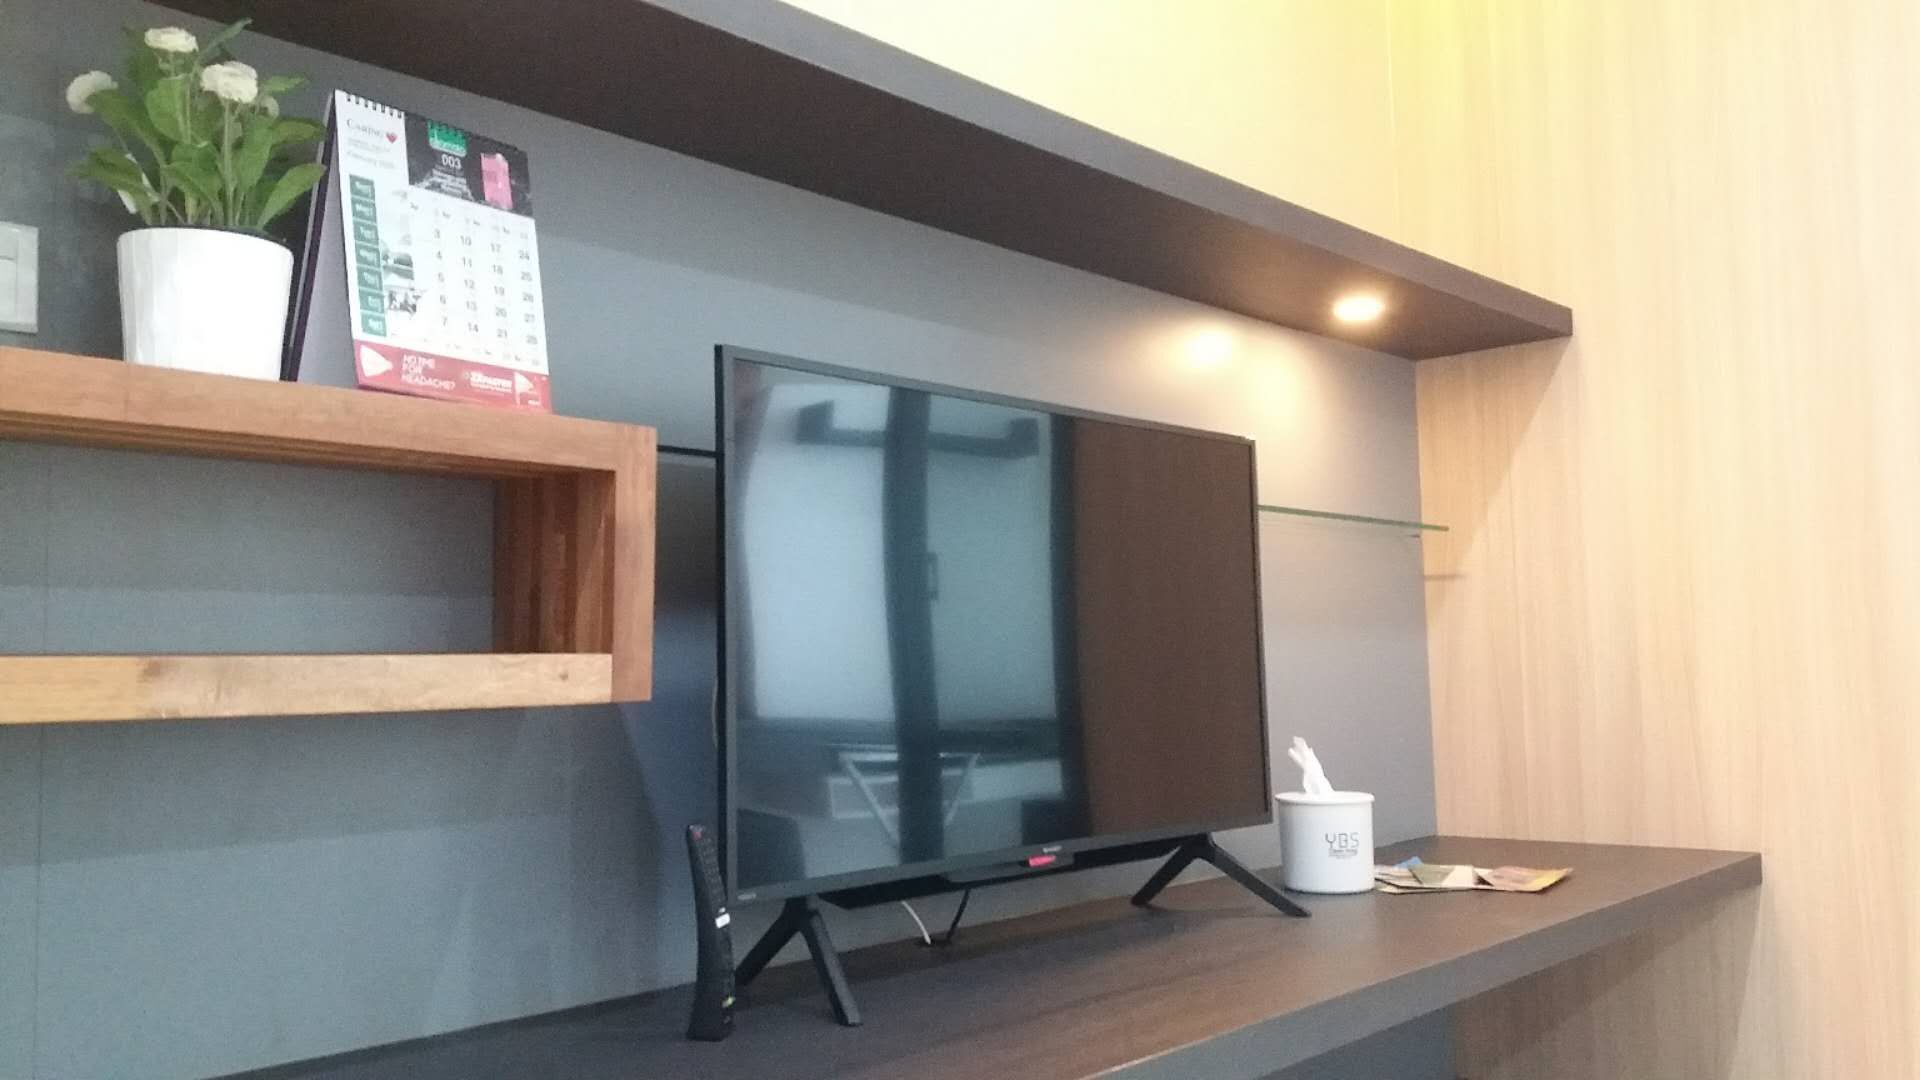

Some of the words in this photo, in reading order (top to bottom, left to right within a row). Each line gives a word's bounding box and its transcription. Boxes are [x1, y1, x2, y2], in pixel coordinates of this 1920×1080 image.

[441, 154, 462, 170] 003
[460, 235, 472, 247] 10
[519, 249, 530, 261] 24
[436, 250, 443, 261] 4
[462, 257, 472, 269] 11
[464, 279, 476, 291] 12
[442, 315, 449, 327] 7
[468, 321, 479, 333] 14
[497, 328, 508, 340] 21
[1324, 832, 1361, 849] YBS
